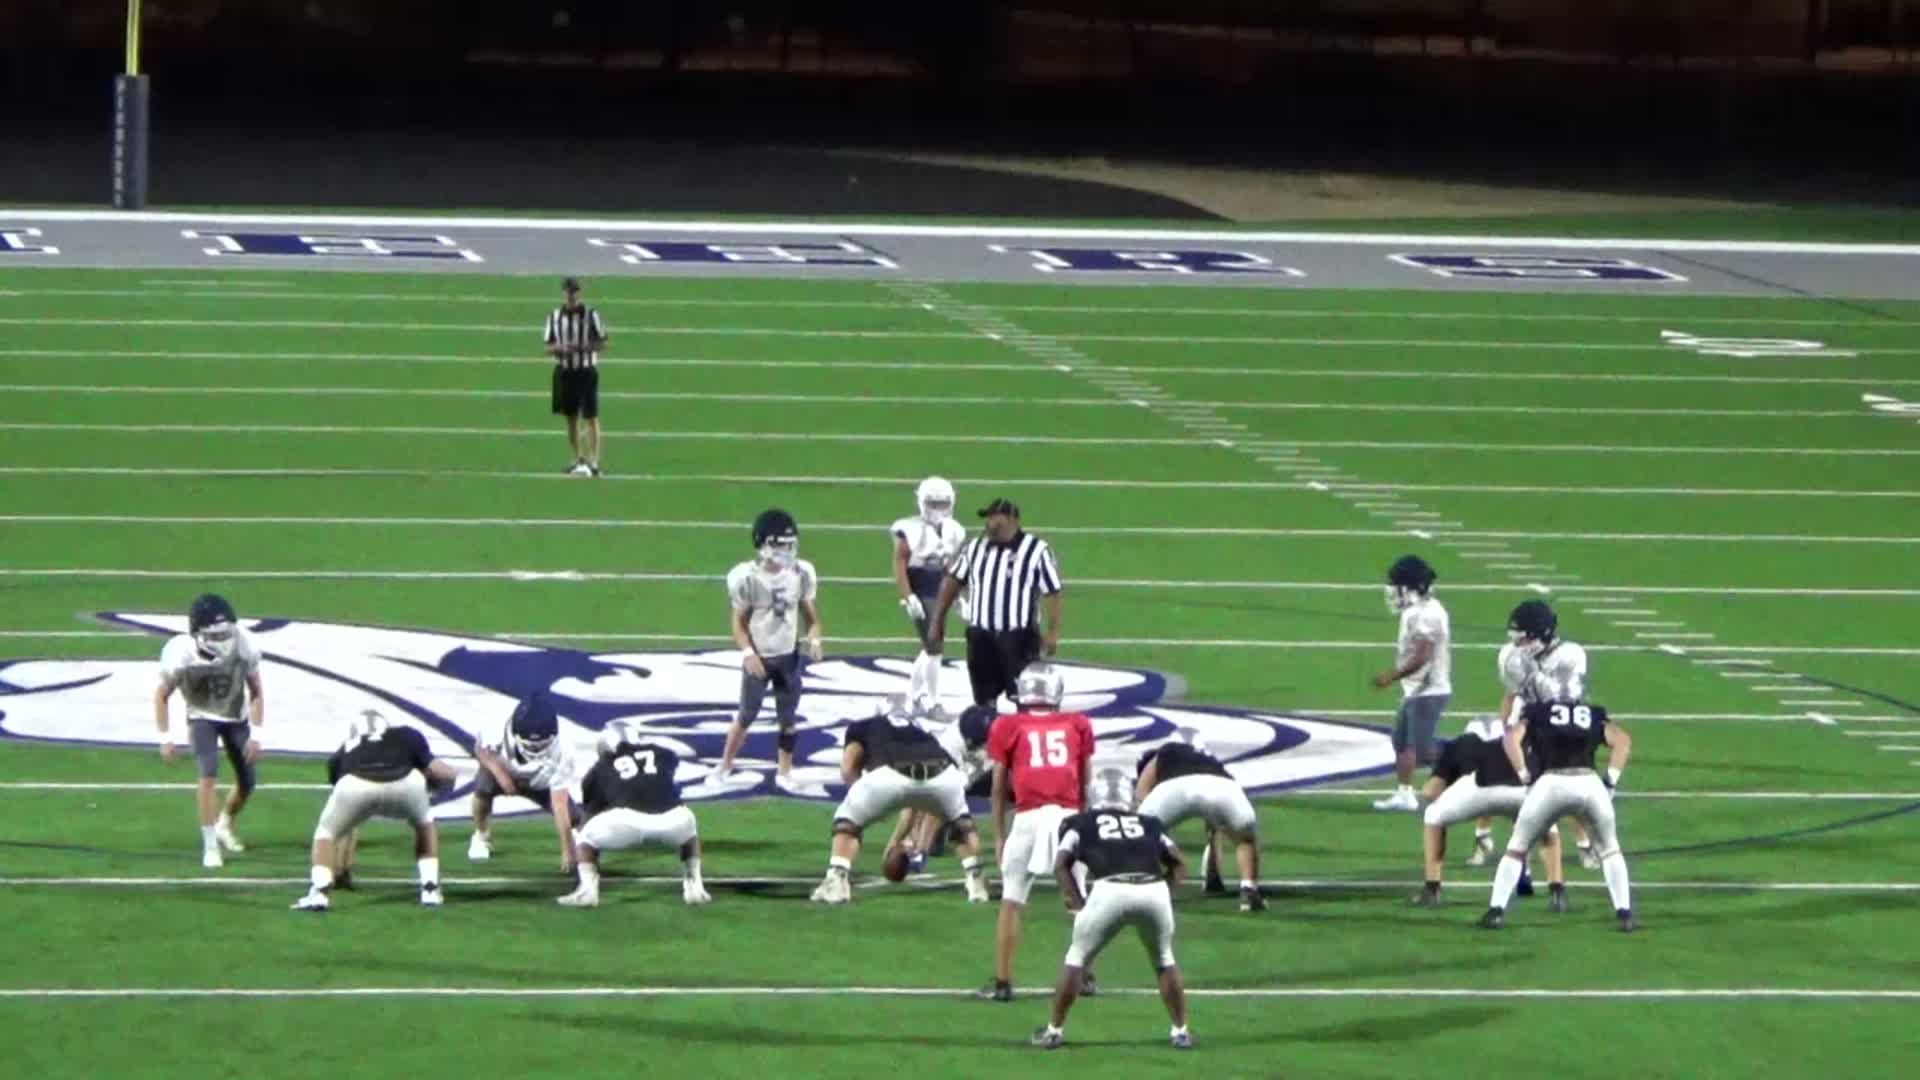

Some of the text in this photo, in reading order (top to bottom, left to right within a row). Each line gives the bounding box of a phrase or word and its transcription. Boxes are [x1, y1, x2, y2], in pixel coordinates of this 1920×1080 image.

[1549, 704, 1592, 729] 36
[1027, 731, 1069, 767] 15
[614, 750, 658, 780] 97
[1096, 814, 1145, 841] 25
